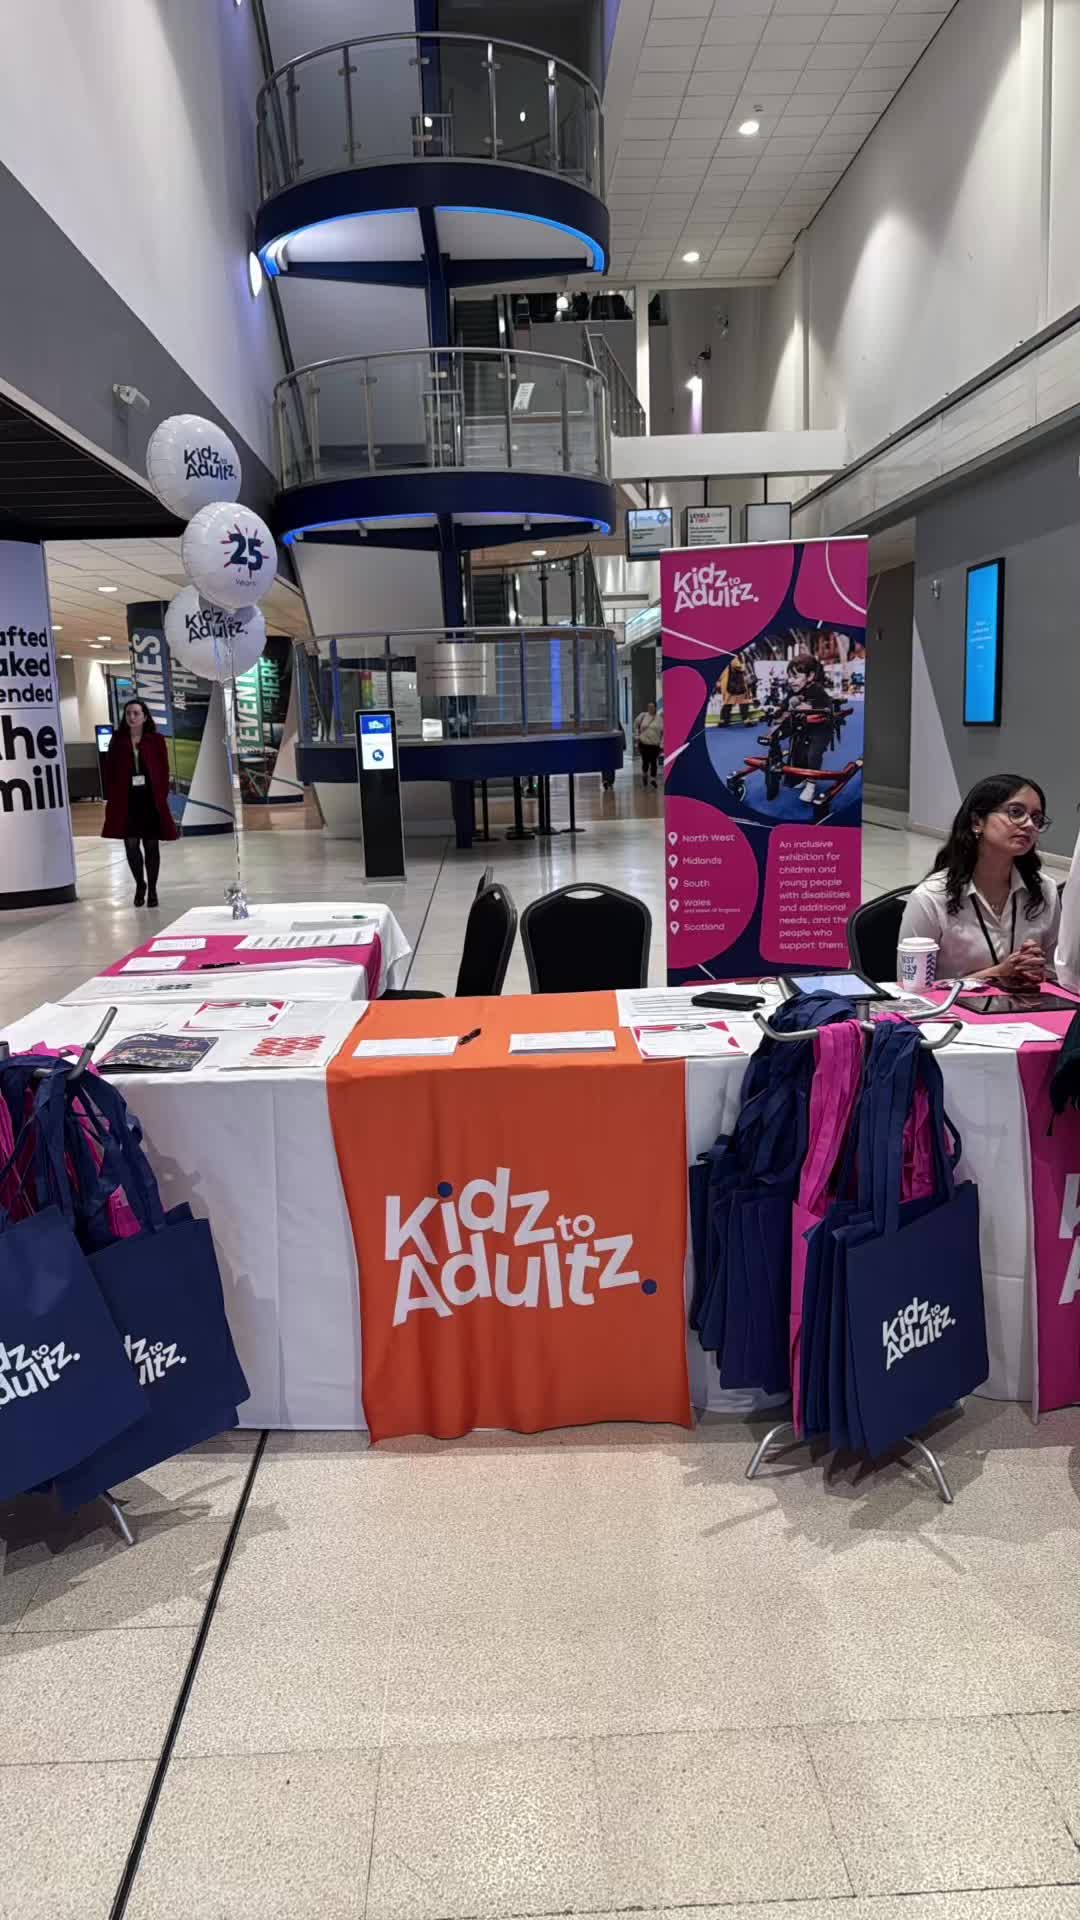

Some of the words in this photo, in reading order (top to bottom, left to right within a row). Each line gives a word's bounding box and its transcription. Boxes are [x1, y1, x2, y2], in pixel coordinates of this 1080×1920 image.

[184, 445, 221, 465] Kidz
[185, 459, 237, 480] Adultz.
[229, 533, 263, 571] 25
[673, 562, 728, 593] Kidz
[728, 577, 741, 586] to
[674, 583, 759, 613] Adultz.
[185, 608, 225, 629] Kidz
[188, 621, 248, 643] Adultz.
[260, 657, 280, 698] HERE
[0, 715, 58, 760] he
[682, 834, 708, 842] North
[711, 834, 736, 842] West
[779, 840, 792, 848] An
[794, 840, 833, 848] inclusive
[682, 857, 722, 865] Midlands
[779, 853, 824, 861] exhibition
[826, 852, 840, 860] for
[779, 866, 816, 874] children
[818, 865, 837, 873] and
[683, 880, 710, 888] South
[779, 880, 808, 889] young
[810, 879, 842, 888] people
[684, 898, 711, 906] Wales
[801, 891, 850, 899] disabilities
[779, 904, 797, 912] and
[800, 904, 846, 912] additional
[684, 923, 725, 931] Scotland
[812, 916, 831, 924] and
[779, 929, 811, 938] people
[814, 929, 833, 937] who
[779, 942, 817, 951] support
[384, 1167, 555, 1265] Kidz
[556, 1214, 596, 1241] to
[392, 1232, 658, 1327] Adultz.
[882, 1297, 931, 1346] Kidz
[931, 1304, 941, 1316] to
[886, 1305, 956, 1371] Adultz.
[32, 1344, 49, 1360] to
[149, 1341, 163, 1356] to
